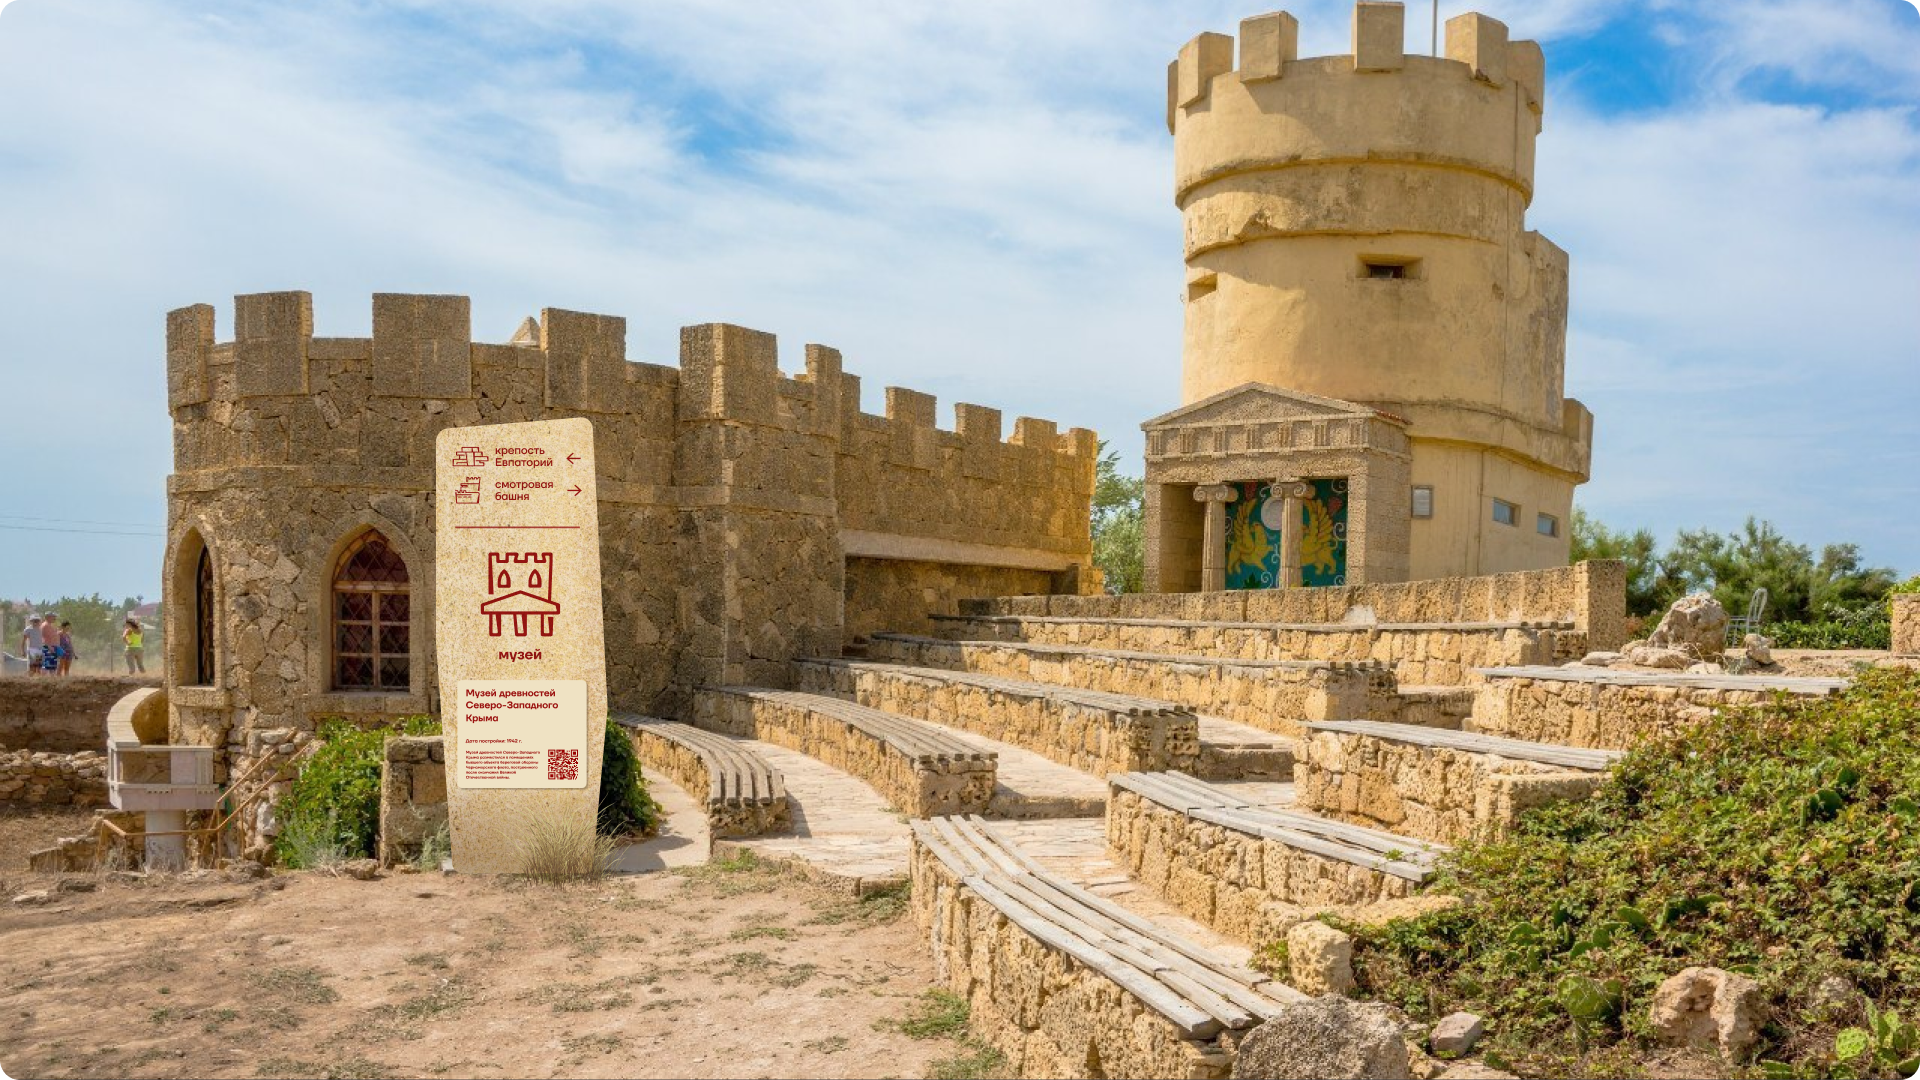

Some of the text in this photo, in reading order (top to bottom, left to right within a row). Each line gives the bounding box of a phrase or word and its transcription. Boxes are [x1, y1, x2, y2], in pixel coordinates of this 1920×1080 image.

[495, 447, 545, 456] крепость
[495, 457, 553, 468] Евпаторий
[495, 481, 554, 490] смотровая
[495, 491, 530, 501] башня
[499, 649, 542, 662] музей
[465, 688, 556, 698] Музей древностей
[465, 701, 559, 710] Северо-Западного
[465, 714, 499, 723] Крыма
